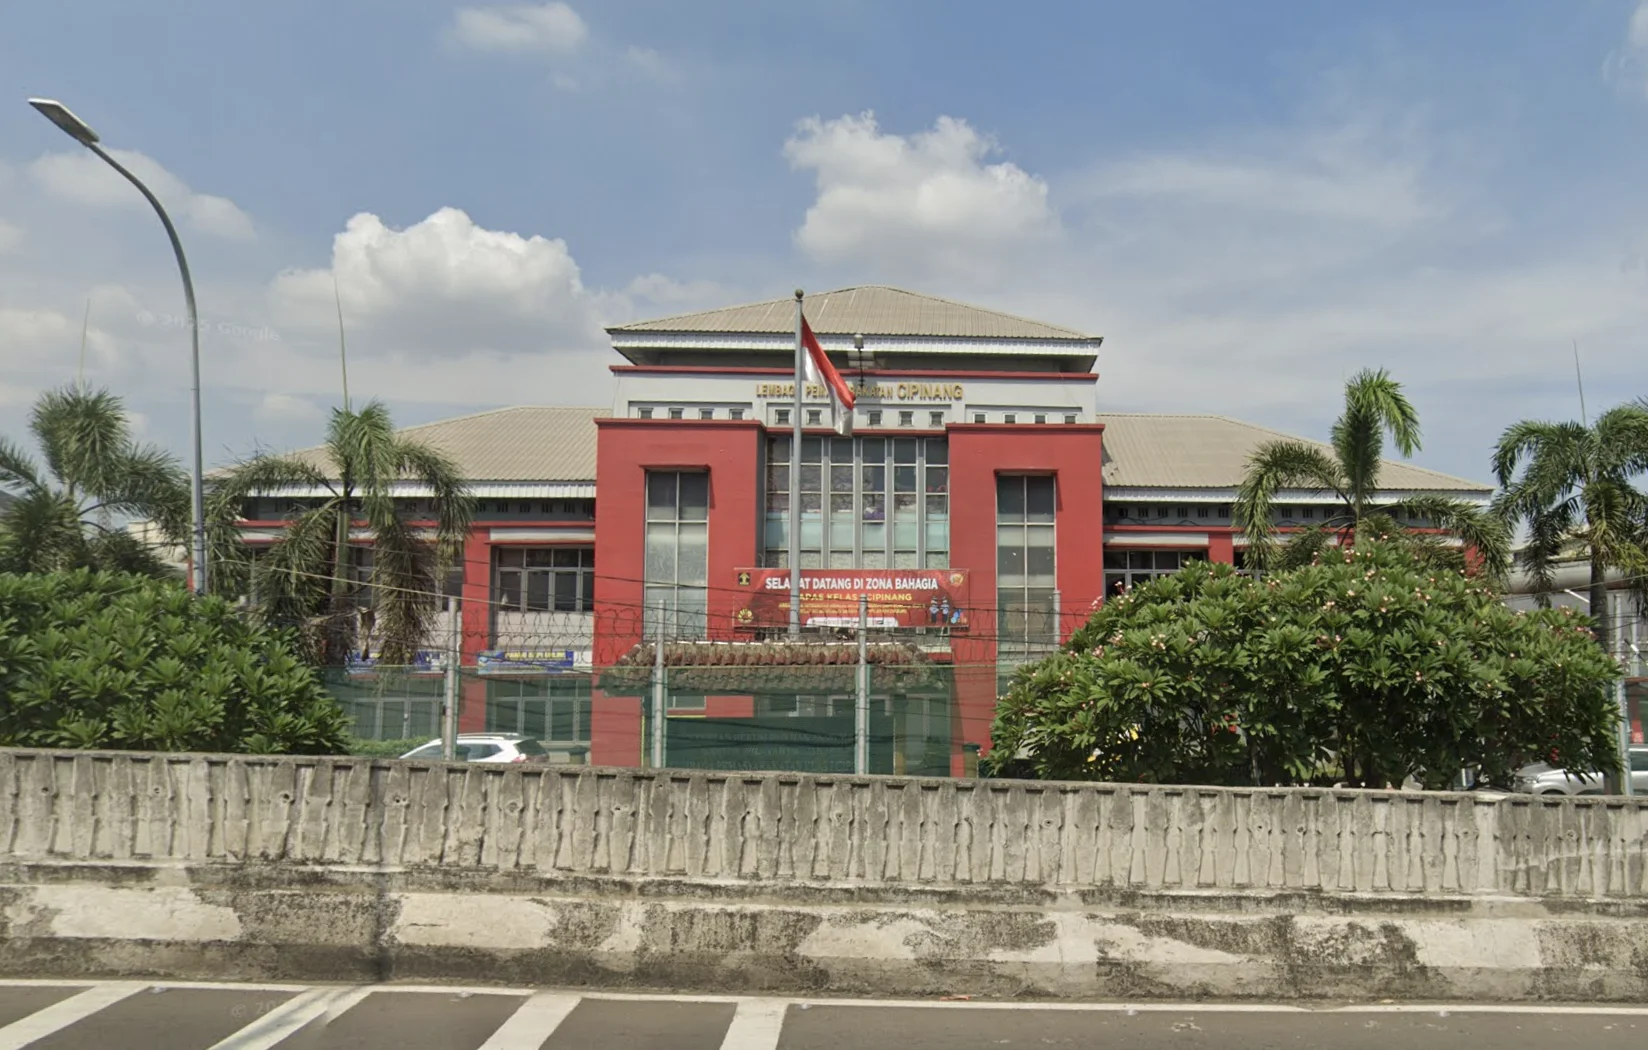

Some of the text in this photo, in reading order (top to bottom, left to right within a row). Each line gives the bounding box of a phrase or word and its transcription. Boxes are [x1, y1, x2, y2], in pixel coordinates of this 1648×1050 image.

[757, 384, 797, 396] LEMBAG
[897, 382, 963, 400] CIPINANG
[765, 577, 938, 589] SELAAT DATANG DI ZONA BAHAGIA
[827, 593, 858, 601] KELAS
[866, 593, 912, 601] CIPINANG
